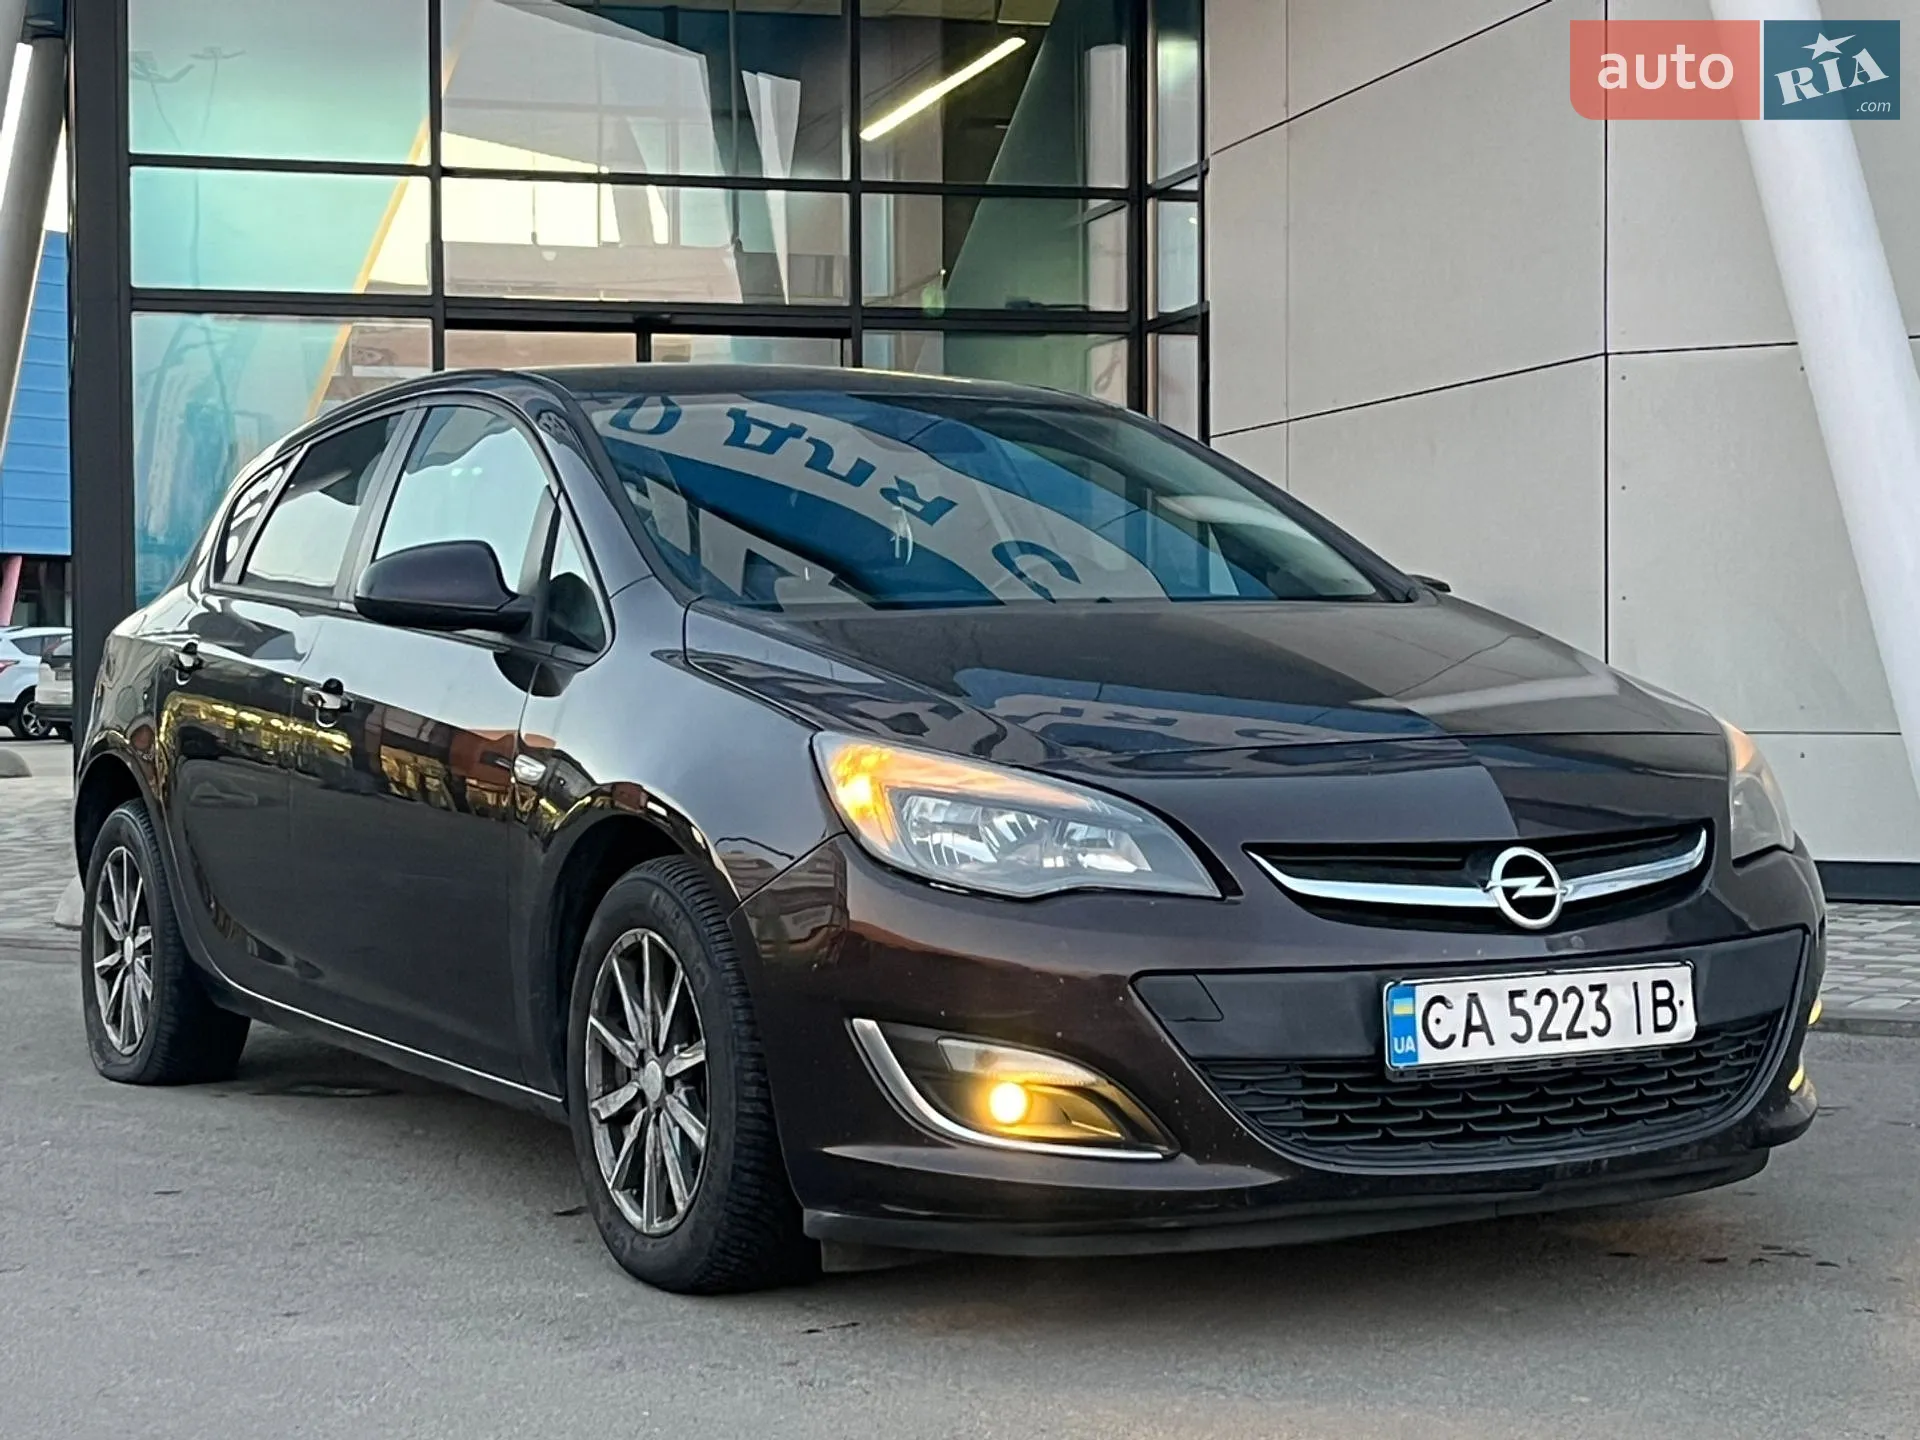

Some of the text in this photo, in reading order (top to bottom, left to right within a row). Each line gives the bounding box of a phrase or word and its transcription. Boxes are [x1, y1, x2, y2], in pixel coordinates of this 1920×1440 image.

[1421, 979, 1679, 1050] CA 5223 IB
[1393, 1036, 1416, 1054] UA
